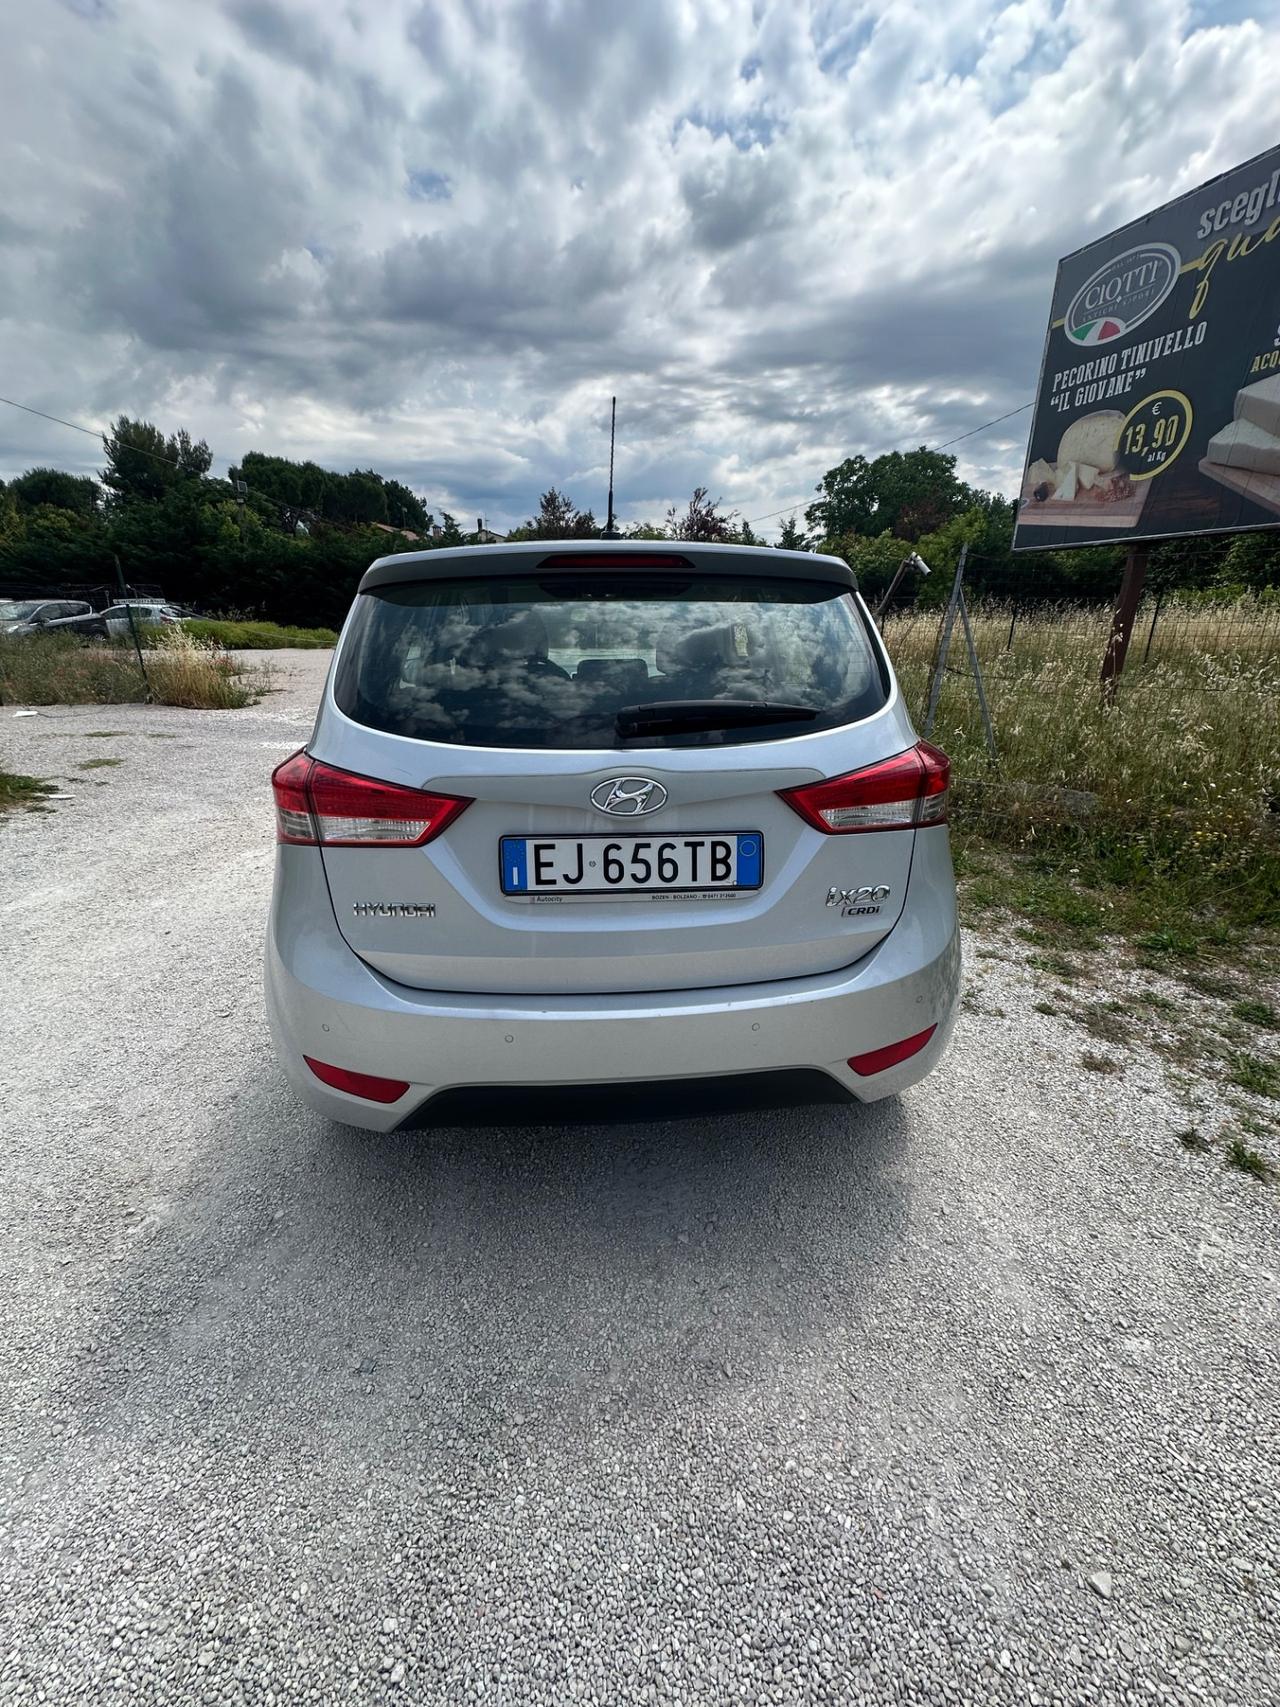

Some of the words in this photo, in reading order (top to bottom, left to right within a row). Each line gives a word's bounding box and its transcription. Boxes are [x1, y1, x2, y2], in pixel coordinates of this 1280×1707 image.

[1197, 169, 1280, 239] scegl
[1085, 260, 1158, 310] CIOTTI
[1052, 353, 1118, 393] PECORINO
[1121, 321, 1208, 370] TINIVELLO
[1151, 401, 1163, 416] €
[1124, 414, 1180, 457] 13,90
[353, 902, 436, 917] HYUNDAI
[537, 895, 563, 903] Autocity
[847, 905, 881, 916] CRDi
